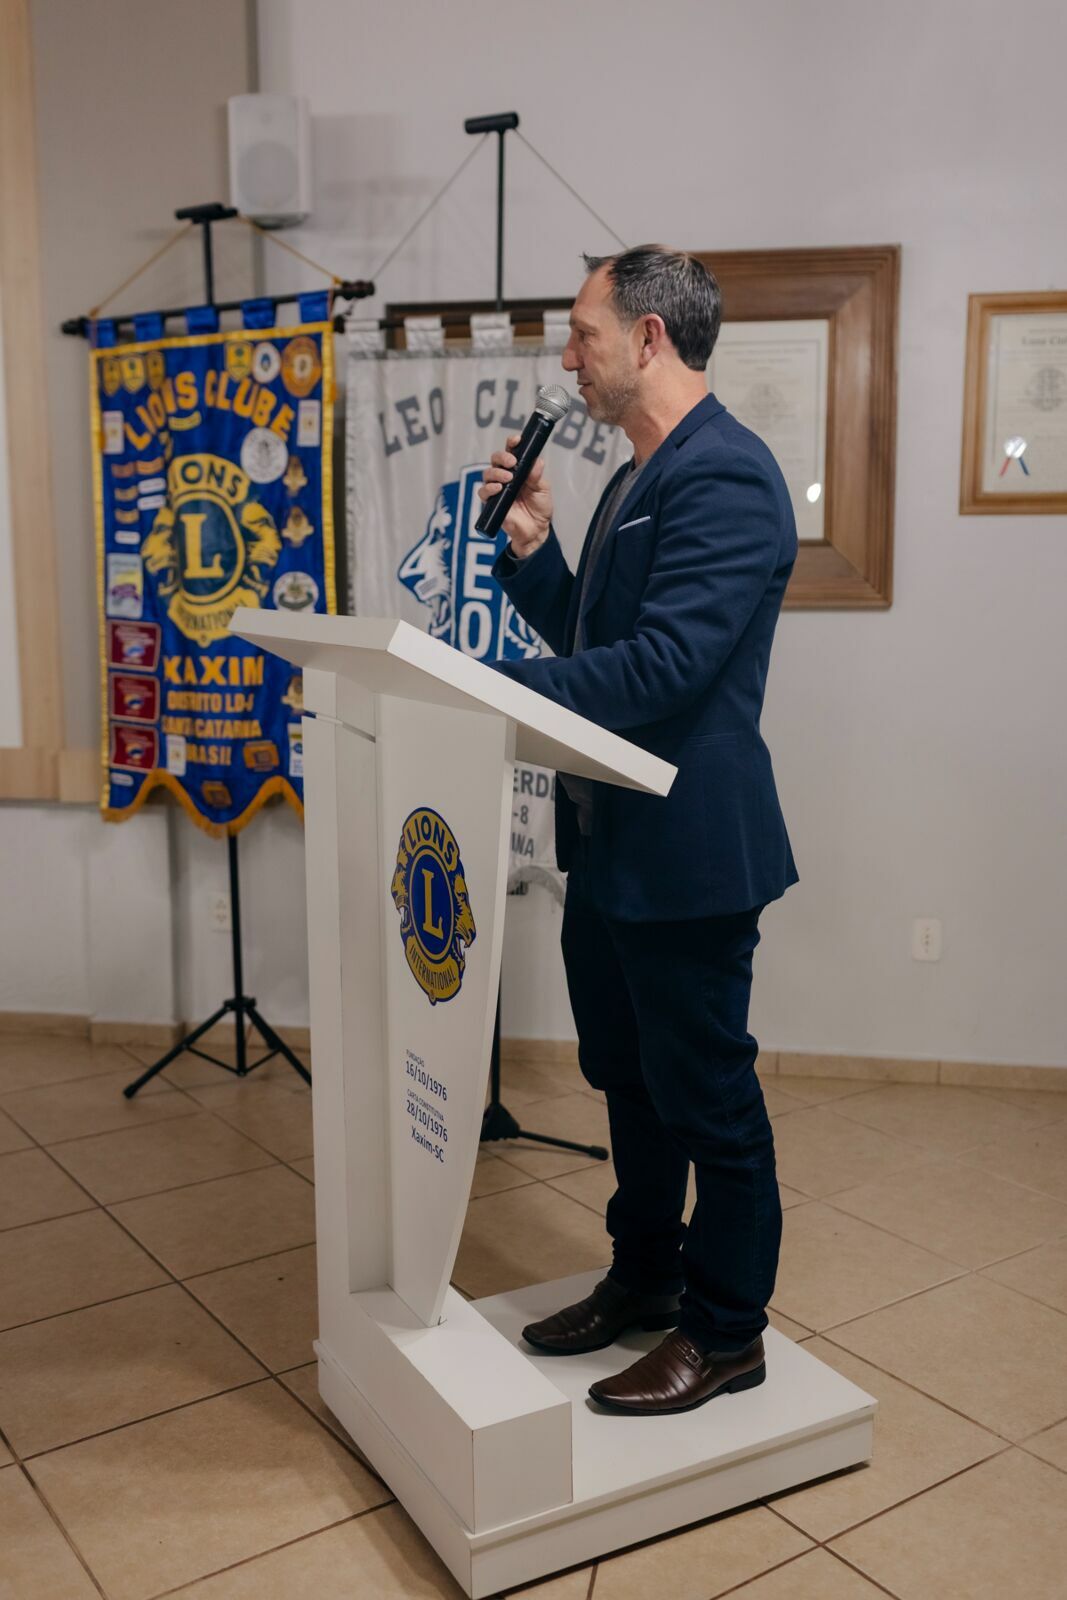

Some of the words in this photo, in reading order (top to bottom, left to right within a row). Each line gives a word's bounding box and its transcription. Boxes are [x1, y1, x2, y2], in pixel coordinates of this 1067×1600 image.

[205, 369, 296, 443] CLUBE
[378, 386, 445, 458] LEO
[474, 379, 616, 466] CLBE
[406, 814, 455, 866] LIONS
[421, 867, 444, 940] L
[409, 942, 458, 992] INTERNATIONAL
[406, 1060, 447, 1101] 16/10/1976
[406, 1099, 448, 1143] 28/10/1976
[411, 1125, 444, 1162] Xaxim-SC
